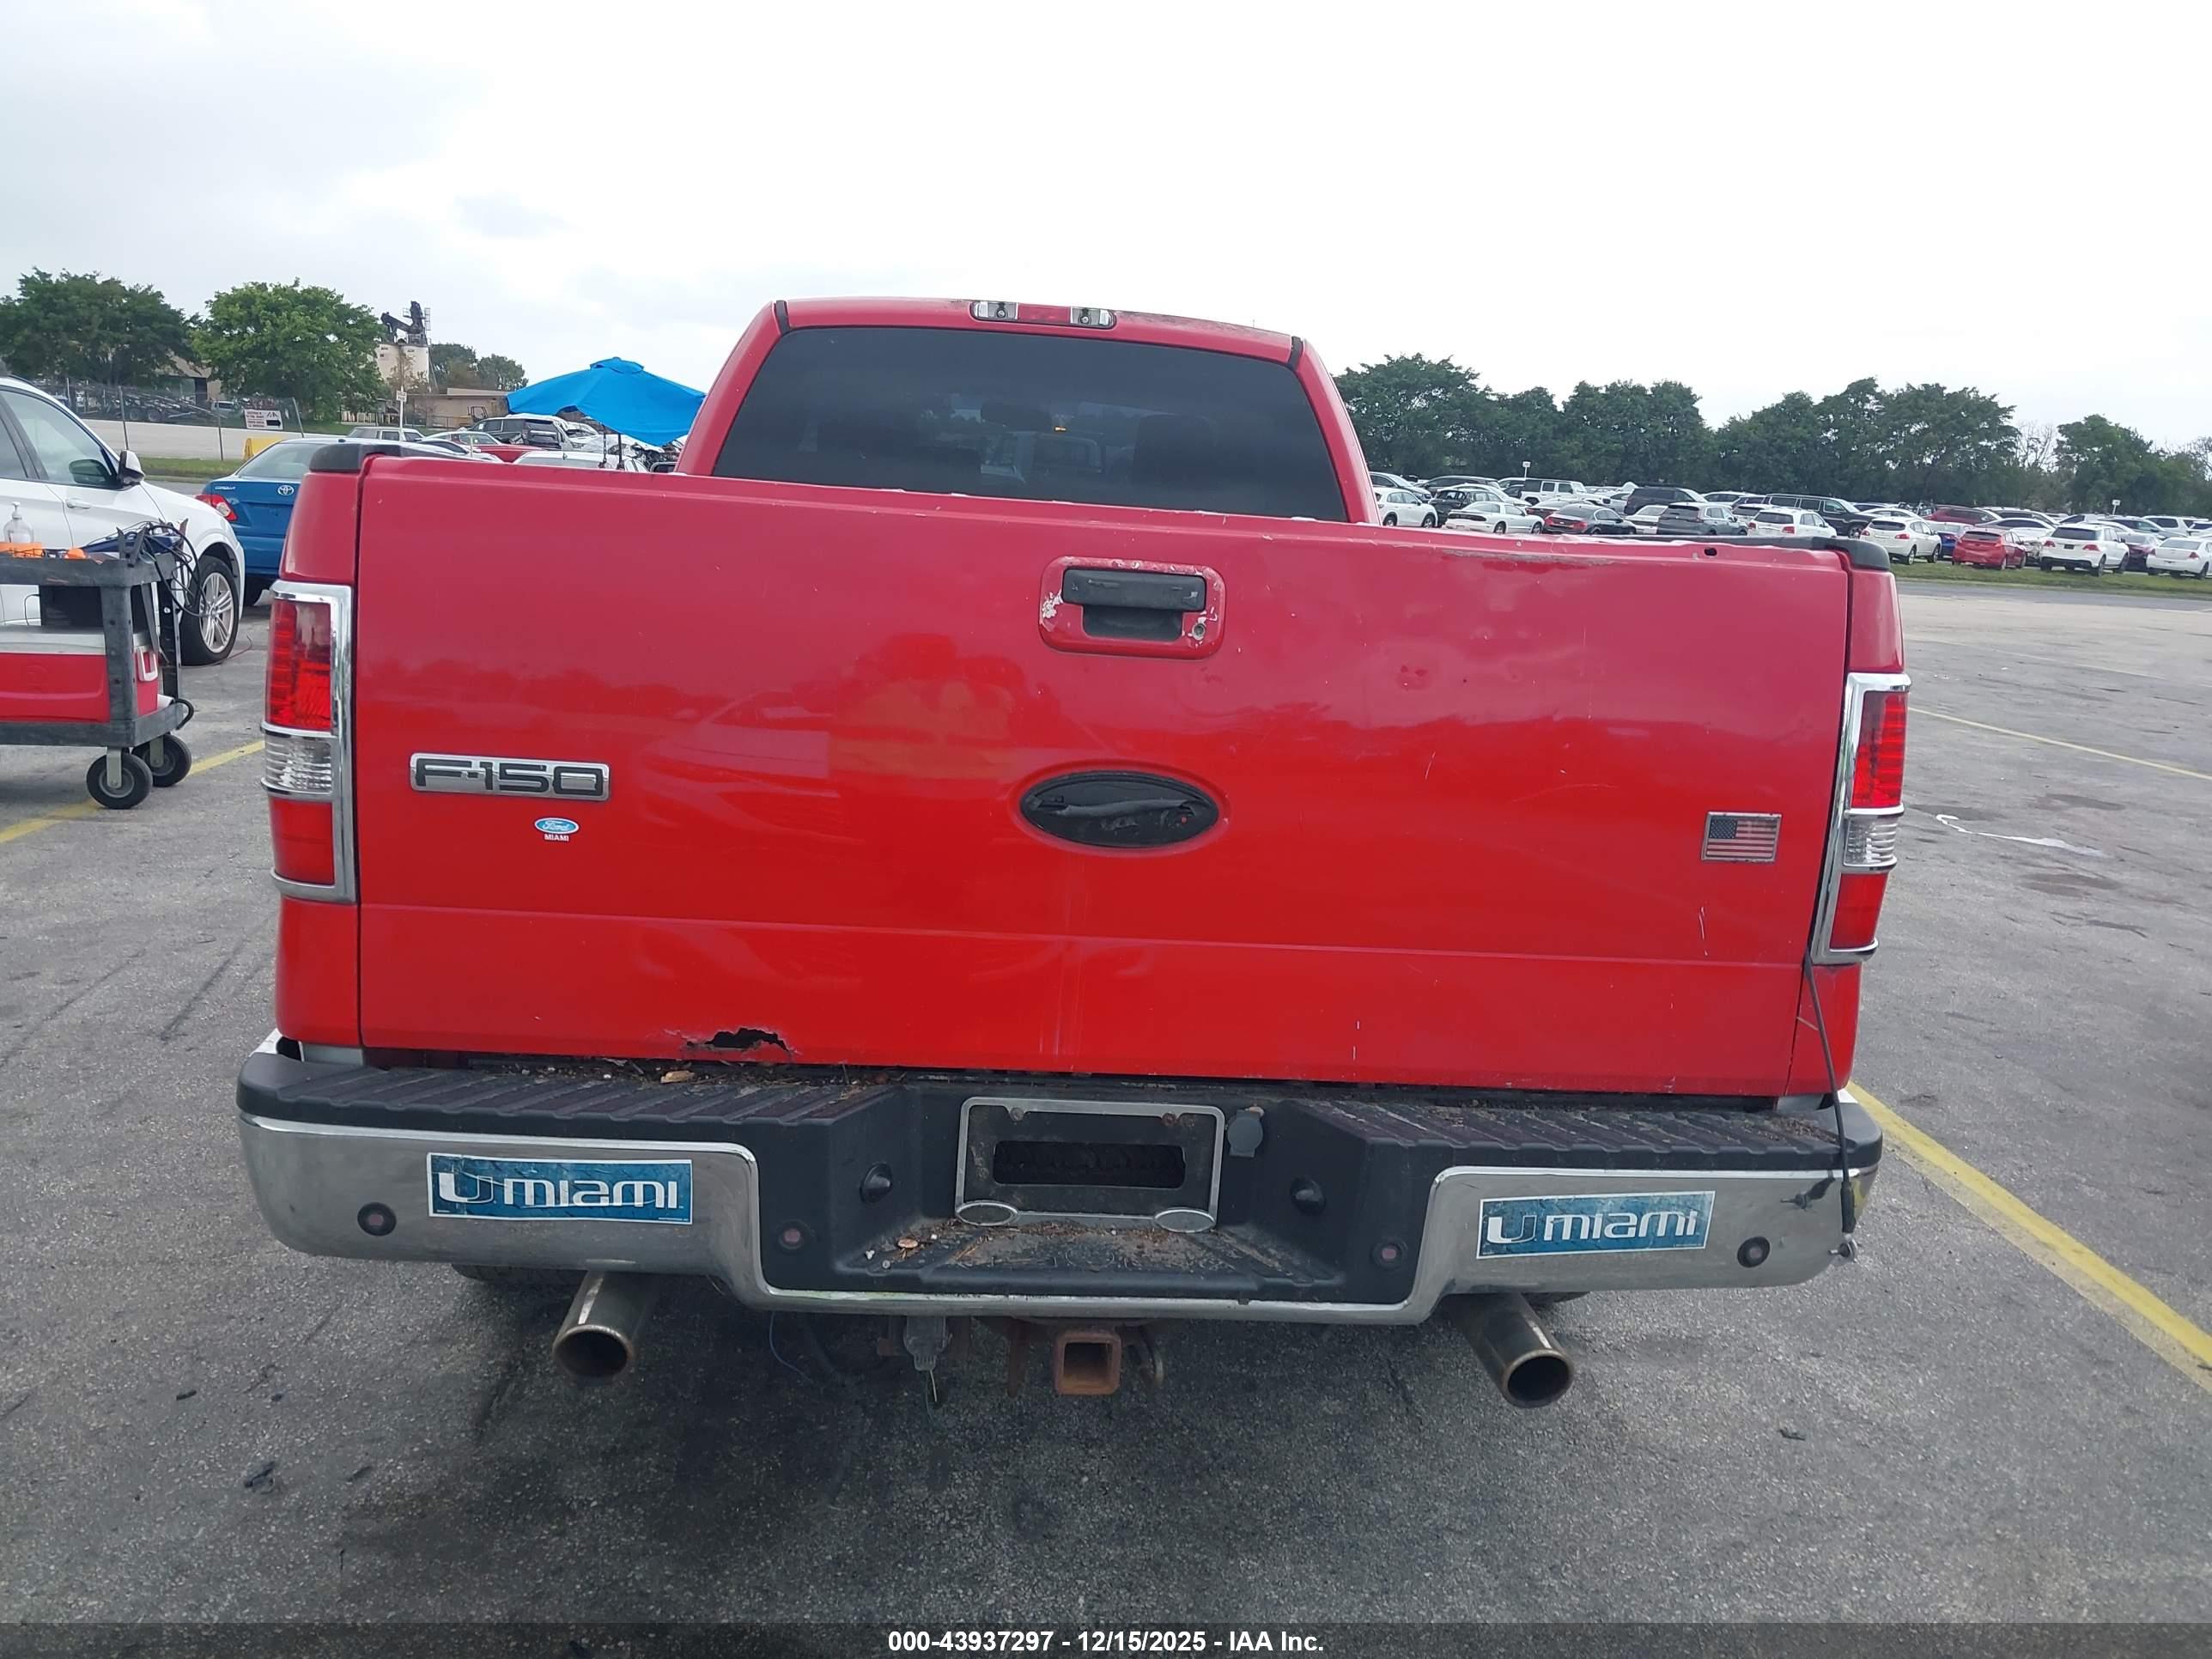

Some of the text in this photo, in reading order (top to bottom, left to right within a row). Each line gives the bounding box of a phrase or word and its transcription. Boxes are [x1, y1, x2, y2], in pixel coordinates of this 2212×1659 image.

[416, 757, 604, 797] F-150
[542, 819, 571, 831] Ford
[544, 833, 569, 842] MIAMI
[438, 1171, 494, 1204] U
[1486, 1214, 1538, 1244] U
